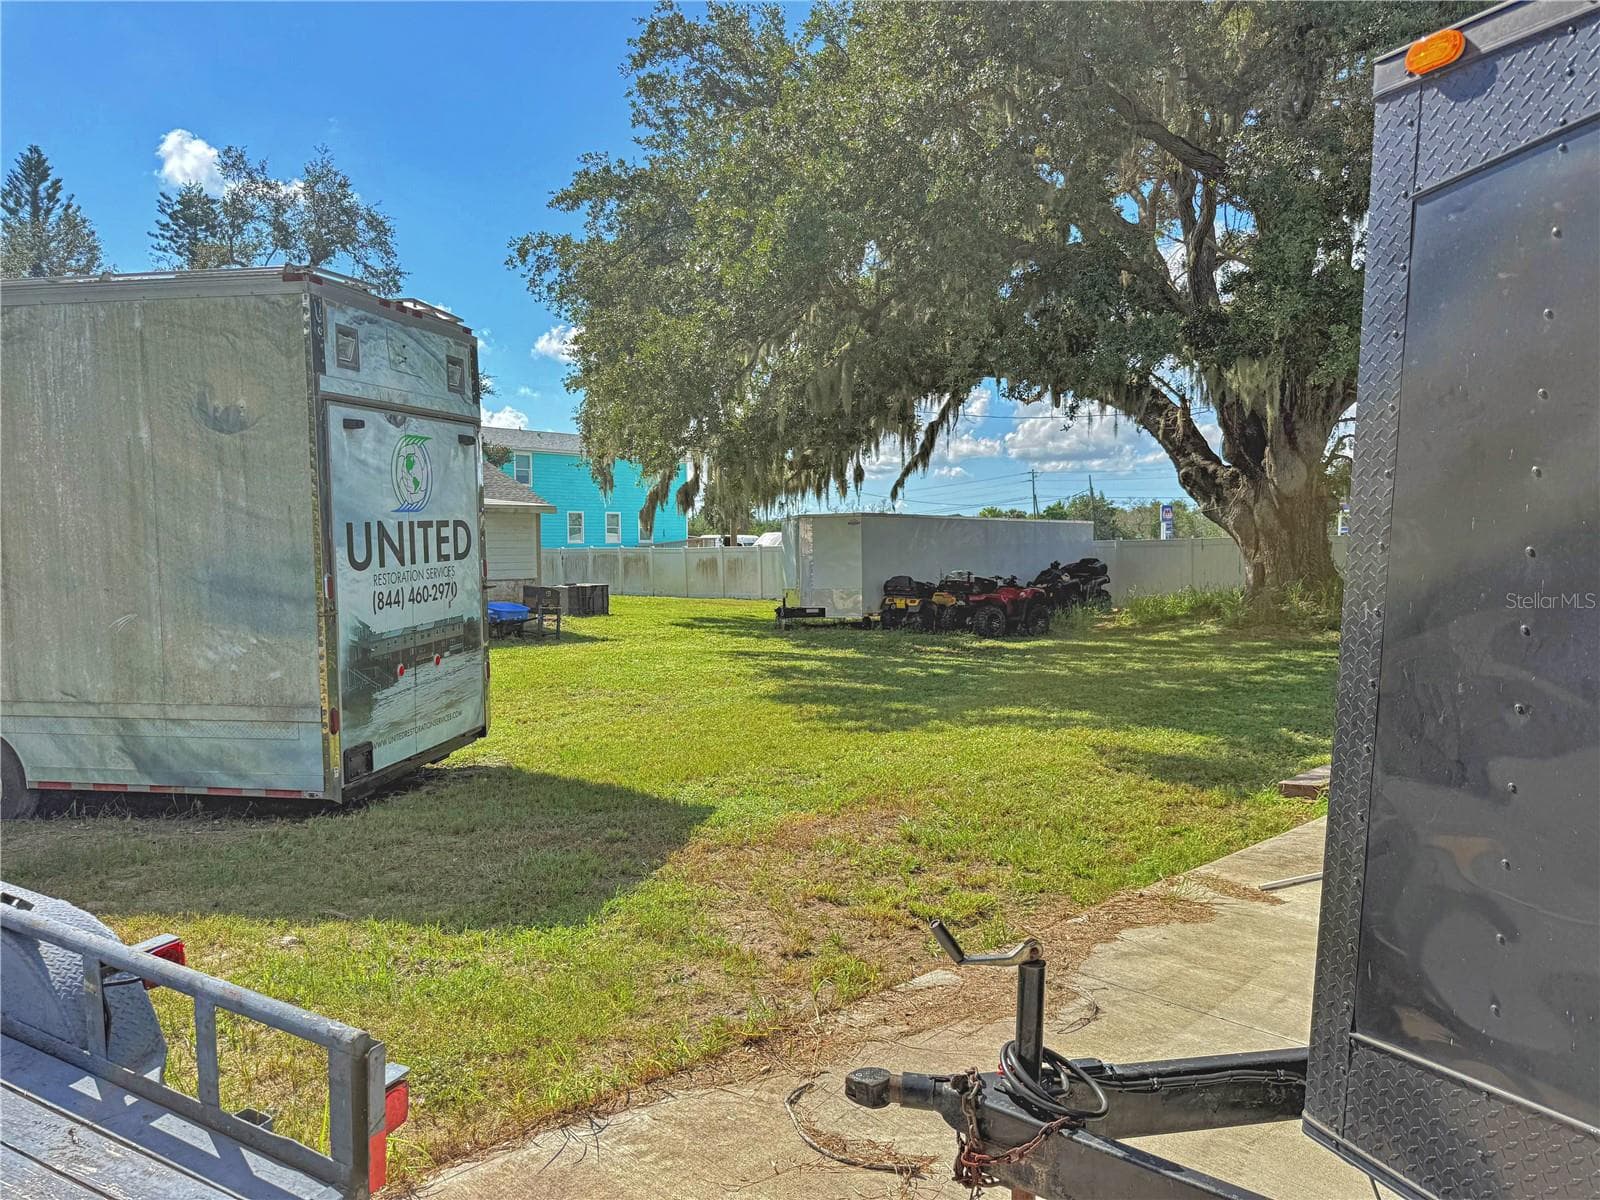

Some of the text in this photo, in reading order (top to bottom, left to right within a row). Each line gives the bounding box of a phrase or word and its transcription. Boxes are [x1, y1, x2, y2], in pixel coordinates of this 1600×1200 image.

[346, 519, 472, 572] UNITED
[373, 565, 456, 586] RESTORATION SERVICES
[372, 581, 458, 615] (844) 460-2970
